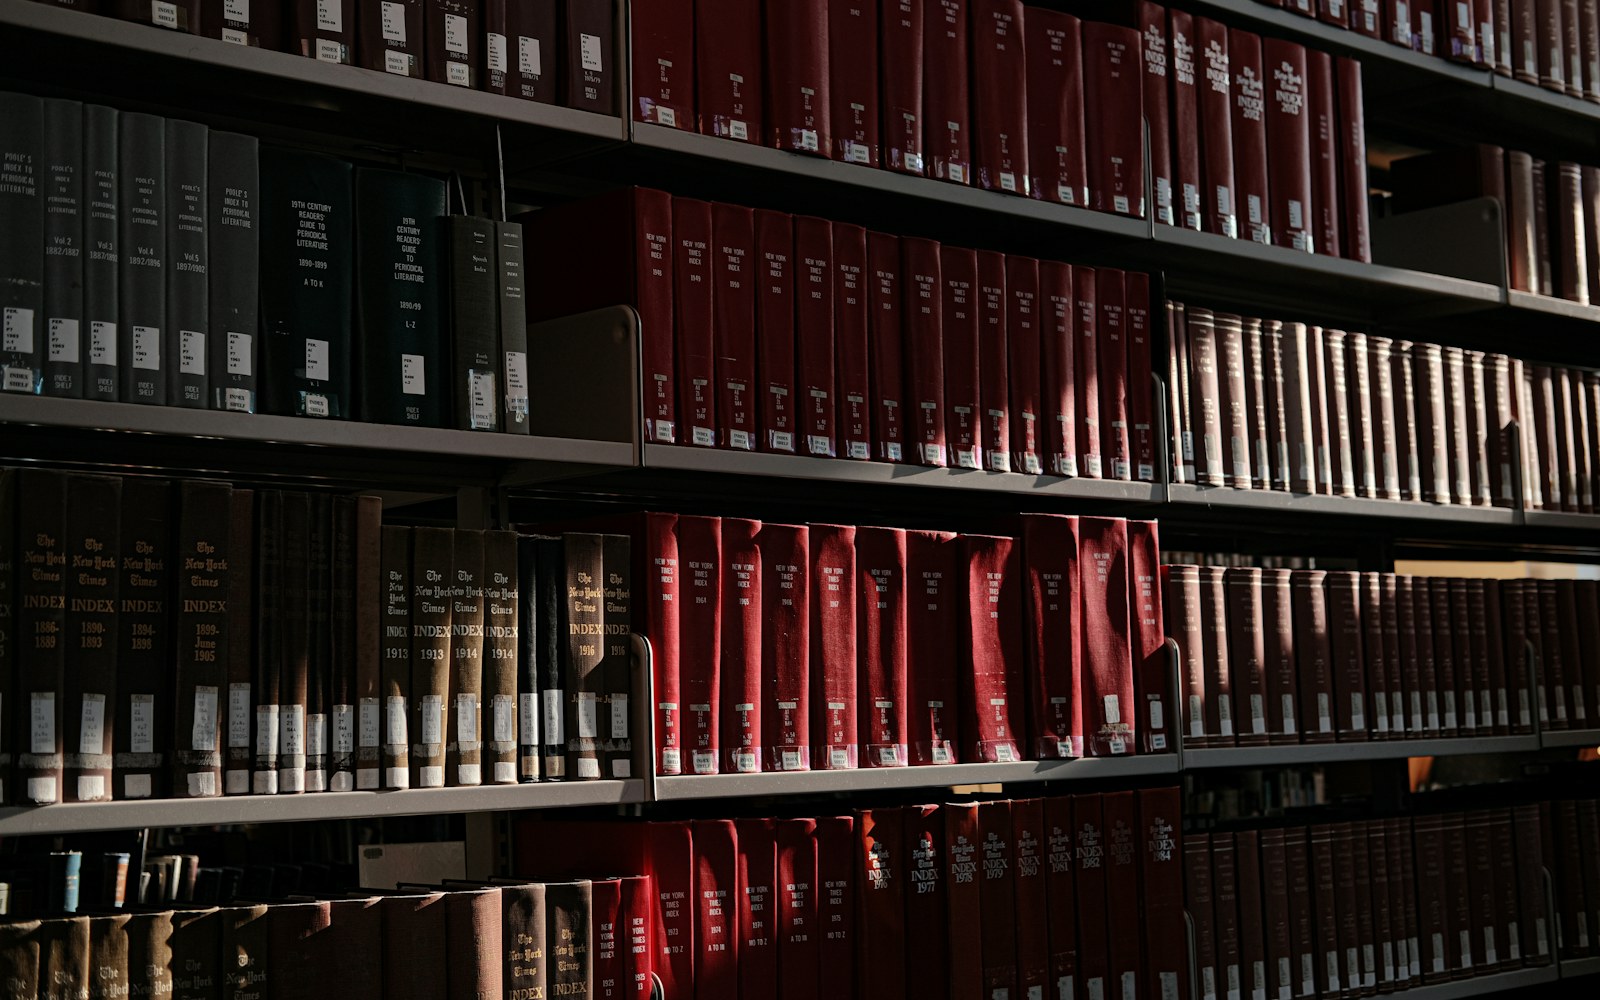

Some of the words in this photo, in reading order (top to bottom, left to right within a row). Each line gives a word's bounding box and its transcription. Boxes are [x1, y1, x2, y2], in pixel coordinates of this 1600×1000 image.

[1238, 94, 1264, 112] INDEX
[1276, 90, 1302, 106] INDEX
[3, 163, 22, 174] INDEX
[24, 164, 32, 174] TO
[51, 165, 73, 174] POOLE'S
[1, 174, 34, 186] PERIODICAL
[55, 175, 70, 183] INDEX
[135, 177, 156, 186] POOLE'S
[0, 184, 36, 196] LITERATURE
[138, 187, 152, 195] INDEX
[182, 184, 200, 192] POOLE'S
[48, 196, 76, 205] PERIODICAL
[224, 196, 240, 208] INDEX
[242, 198, 248, 208] TO
[291, 200, 306, 210] 19TH
[306, 202, 332, 213] CENTURY
[48, 206, 76, 216] LITERATURE
[132, 208, 158, 217] PERIODICAL
[222, 206, 250, 218] PERIODICAL
[132, 218, 158, 226] LITERATURE
[178, 214, 202, 223] PERIODICAL
[222, 217, 251, 229] LITERATURE
[402, 216, 416, 226] 19TH
[178, 224, 202, 233] LITERATURE
[300, 220, 316, 230] GUIDE
[318, 221, 326, 231] TO
[396, 226, 421, 236] CENTURY
[296, 229, 328, 241] PERIODICAL
[296, 239, 328, 250] LITERATURE
[402, 244, 416, 254] GUIDE
[46, 246, 80, 257] 1882/1887
[129, 256, 160, 268] 1892/1896
[299, 258, 328, 270] 1890-1899
[406, 254, 414, 262] TO
[805, 257, 815, 266] NEW
[816, 258, 827, 268] YORK
[176, 262, 206, 274] 1897/1902
[394, 263, 424, 274] PERIODICAL
[810, 266, 822, 275] TIMES
[304, 278, 309, 287] A
[310, 278, 318, 288] TO
[318, 279, 324, 288] K
[394, 272, 425, 284] LITERATURE
[810, 275, 822, 283] INDEX
[406, 320, 416, 329] L-Z
[54, 375, 72, 384] INDEX
[55, 381, 72, 390] SHELF
[185, 386, 199, 394] INDEX
[185, 392, 200, 401] SHELF
[36, 533, 56, 548] The
[84, 538, 104, 552] The
[136, 540, 154, 554] The
[197, 540, 215, 555] The
[25, 550, 44, 564] New
[46, 552, 66, 567] York
[72, 554, 93, 568] New
[94, 556, 116, 572] York
[123, 556, 144, 570] New
[145, 557, 164, 573] York
[184, 558, 204, 571] New
[206, 558, 228, 572] York
[700, 562, 714, 570] YORK
[32, 568, 60, 582] Times
[78, 572, 108, 586] Times
[390, 570, 402, 582] The
[426, 570, 442, 582] The
[458, 570, 473, 582] The
[494, 572, 509, 584] The
[576, 572, 592, 584] The
[610, 572, 624, 584] The
[694, 570, 708, 578] TIMES
[130, 574, 158, 588] Times
[191, 575, 219, 588] Times
[388, 581, 404, 592] New
[694, 578, 708, 587] INDEX
[415, 585, 432, 598] New
[434, 586, 451, 600] York
[466, 586, 484, 599] York
[484, 588, 500, 599] New
[570, 586, 586, 598] New
[587, 587, 602, 600] York
[24, 594, 66, 608] INDEX
[389, 592, 406, 606] York
[72, 598, 115, 613] INDEX
[122, 600, 162, 614] INDEX
[184, 599, 228, 614] INDEX
[388, 605, 408, 616] Times
[422, 602, 446, 614] Times
[454, 602, 478, 614] Times
[490, 604, 514, 616] Times
[574, 601, 597, 613] Times
[606, 602, 627, 614] Times
[386, 625, 408, 638] INDEX
[414, 625, 451, 638] INDEX
[452, 625, 484, 637] NDEX
[485, 626, 518, 638] INDEX
[570, 624, 602, 636] INDEX
[34, 636, 56, 649] 1889
[80, 636, 102, 649] 1893
[194, 636, 216, 650] June
[194, 650, 216, 662] 1905
[386, 647, 409, 660] 1913
[420, 648, 444, 660] 1913
[456, 648, 478, 660] 1914
[492, 648, 514, 660] 1914
[579, 645, 594, 656] 1916
[611, 645, 626, 656] 1916
[1148, 839, 1177, 852] INDEX
[1076, 846, 1104, 859] INDEX
[952, 862, 976, 874] INDEX
[982, 858, 1008, 870] INDEX
[1082, 857, 1102, 870] 1982
[912, 868, 940, 882] INDEX
[986, 868, 1004, 880] 1979
[916, 881, 936, 894] 1977
[672, 892, 684, 900] YORK
[666, 900, 680, 909] TIMES
[666, 910, 680, 918] INDEX
[601, 922, 613, 932] NEW
[600, 932, 614, 941] YORK
[600, 941, 615, 950] TIMES
[600, 950, 615, 960] INDEX
[508, 986, 543, 1000] INDEX
[553, 981, 587, 996] INDEX
